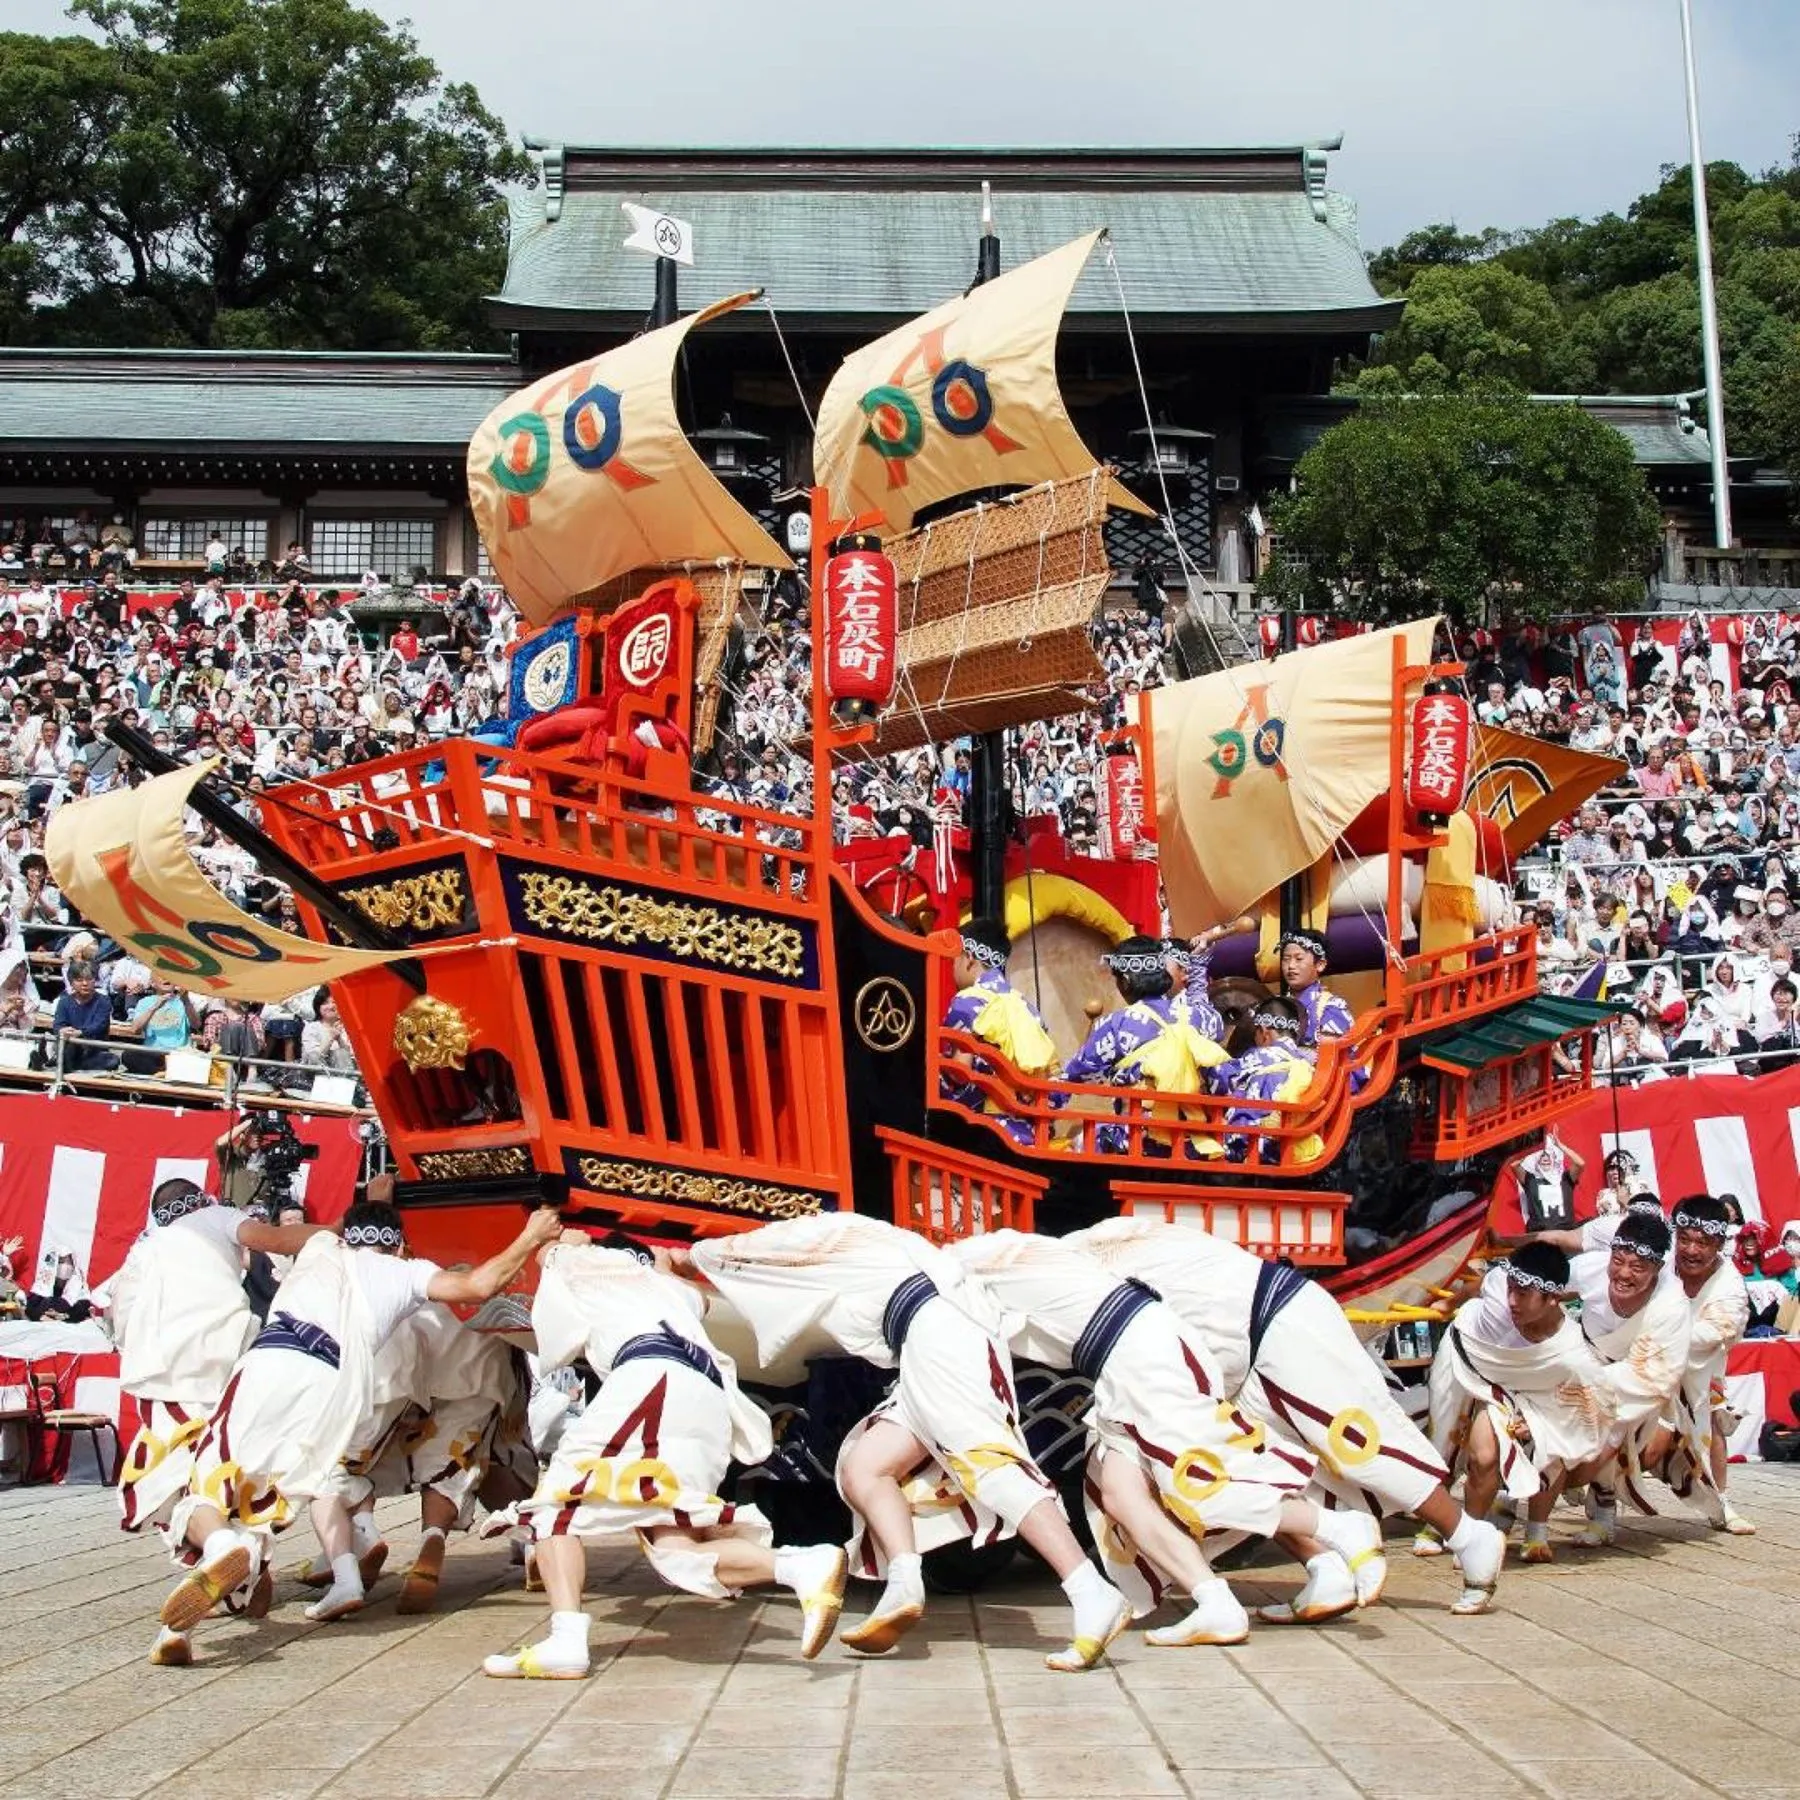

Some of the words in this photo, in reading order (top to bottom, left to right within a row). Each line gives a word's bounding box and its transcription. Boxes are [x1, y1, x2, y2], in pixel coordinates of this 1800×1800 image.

[836, 558, 886, 681] 本石灰町
[1420, 699, 1461, 798] 本石灰町
